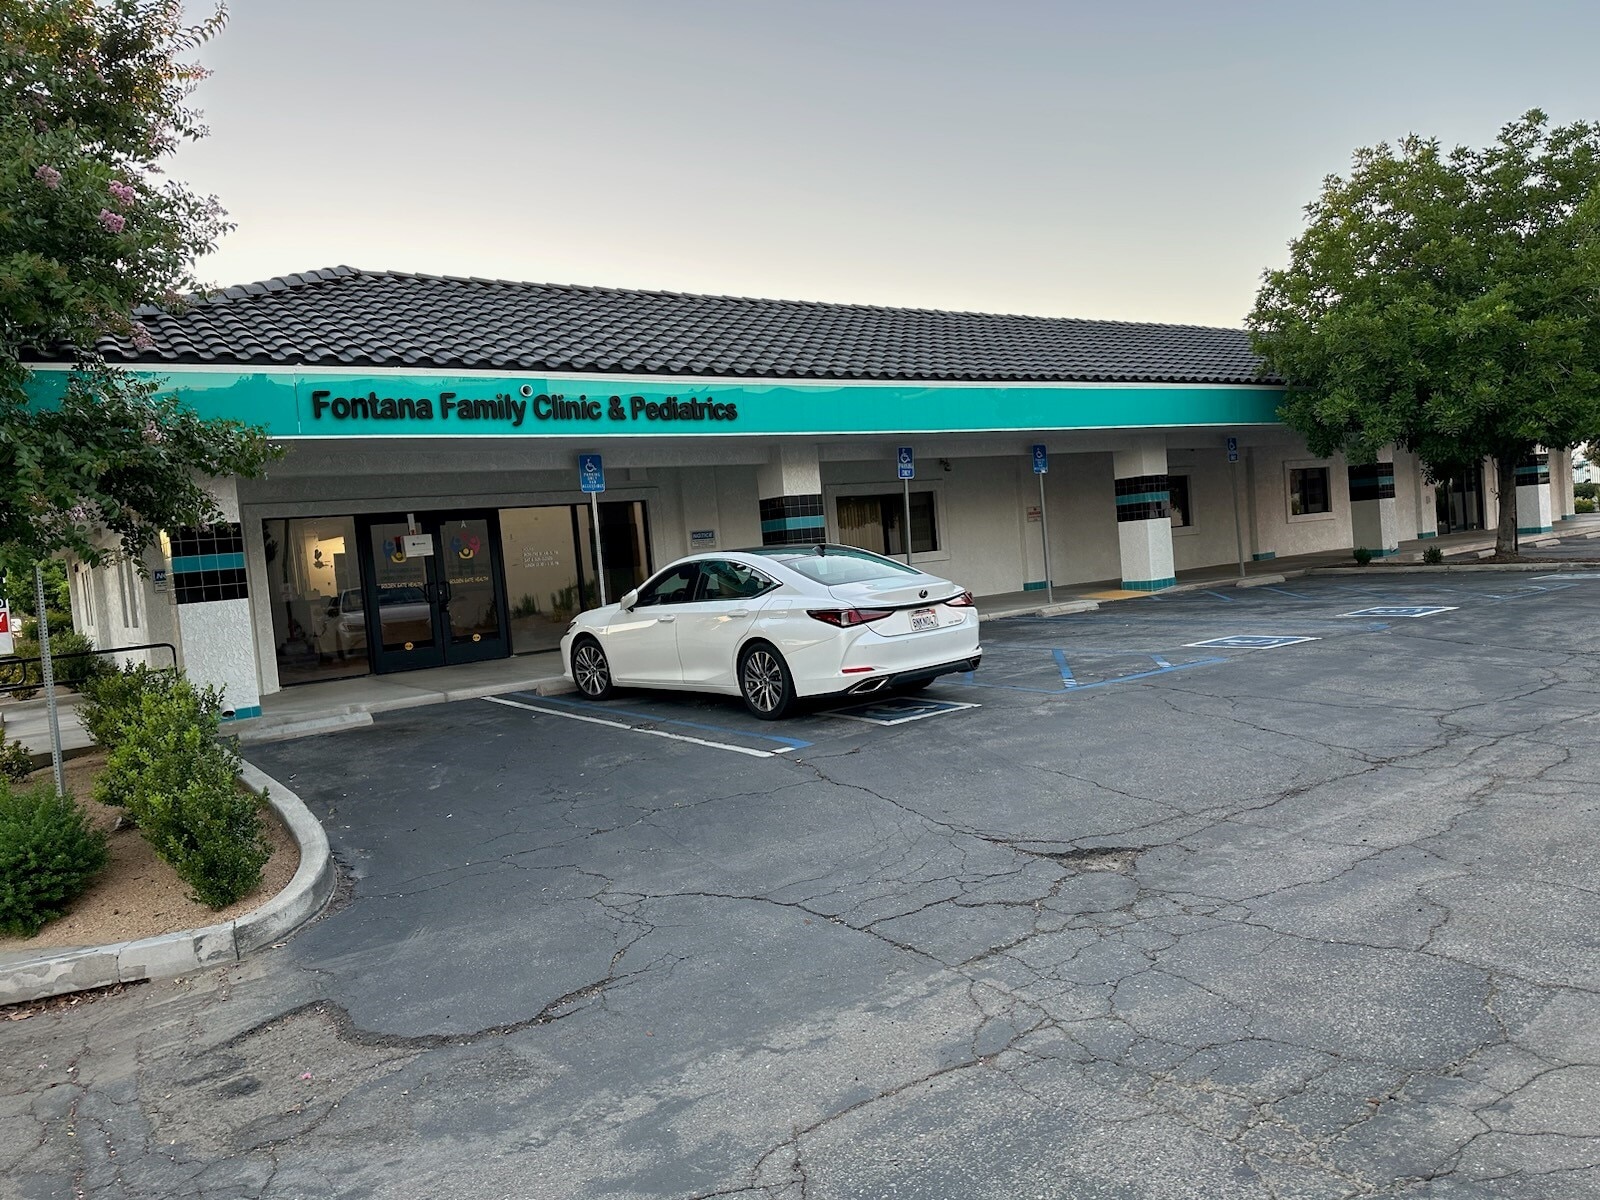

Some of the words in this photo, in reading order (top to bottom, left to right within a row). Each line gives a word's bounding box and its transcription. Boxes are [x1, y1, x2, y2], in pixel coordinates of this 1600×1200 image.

[312, 391, 433, 419] Fontana
[440, 392, 527, 427] Family
[534, 394, 602, 420] Clinic
[608, 395, 626, 420] &
[630, 396, 738, 421] Pediatrics
[692, 531, 713, 539] NOTICE
